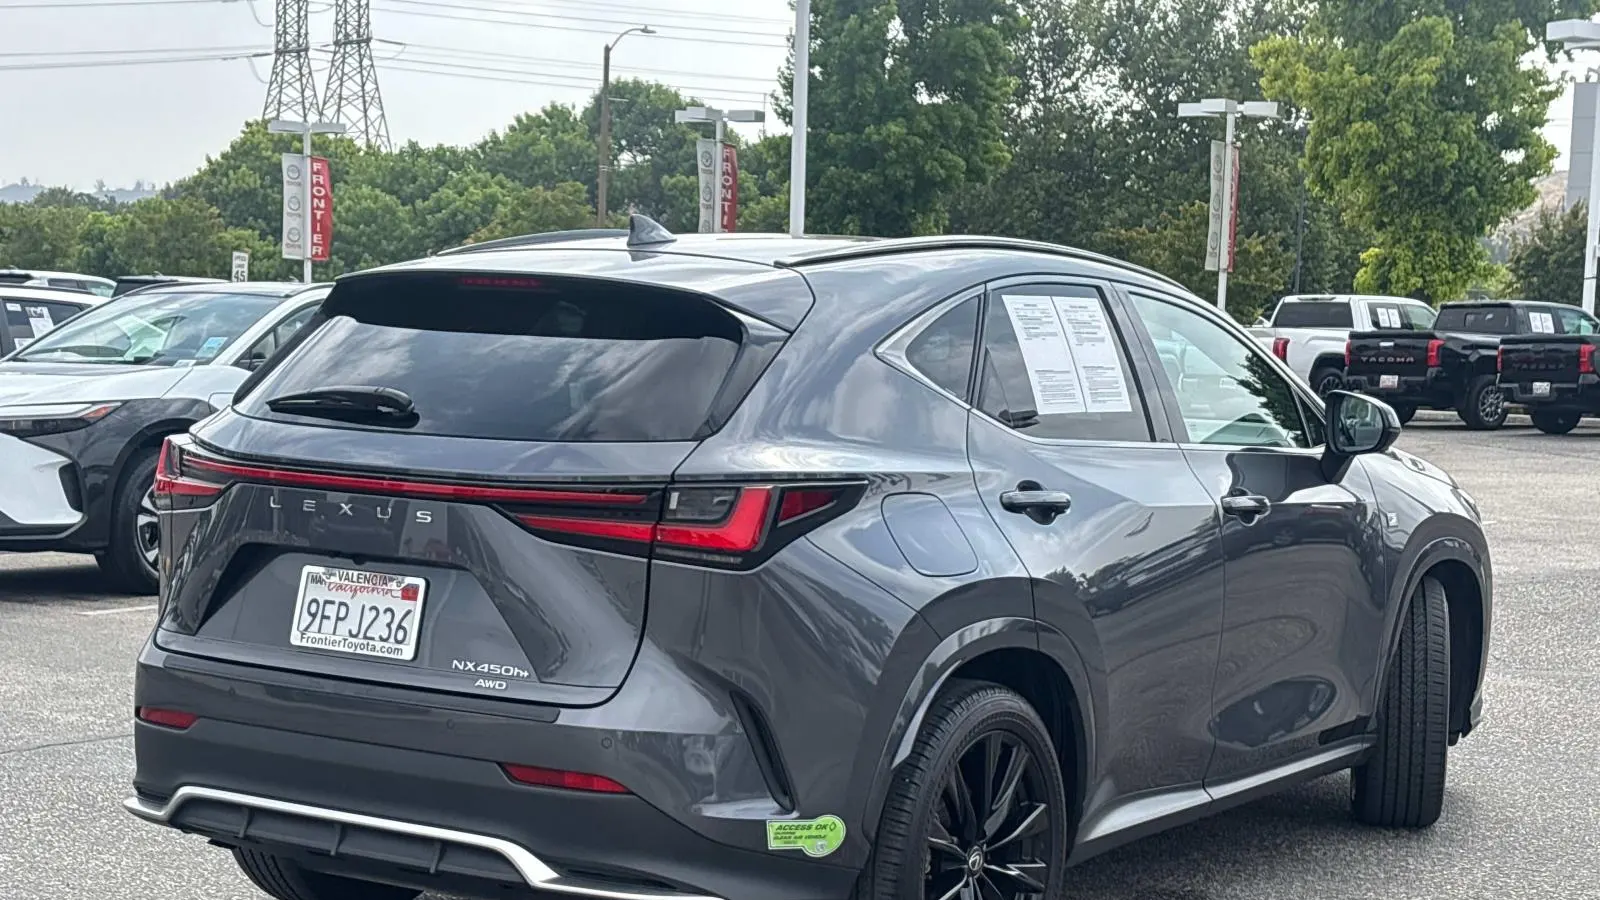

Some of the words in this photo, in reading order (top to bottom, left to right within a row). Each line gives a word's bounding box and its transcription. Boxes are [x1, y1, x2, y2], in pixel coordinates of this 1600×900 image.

[720, 147, 732, 233] FRONTI
[312, 162, 326, 256] FRONTIER
[233, 269, 246, 282] 45
[269, 495, 432, 523] LEXUS
[337, 571, 389, 587] VALENCIA
[303, 597, 413, 645] 9FPJ236
[300, 633, 403, 656] FrontierToyota.com
[474, 678, 507, 690] AWD
[815, 823, 829, 831] OK
